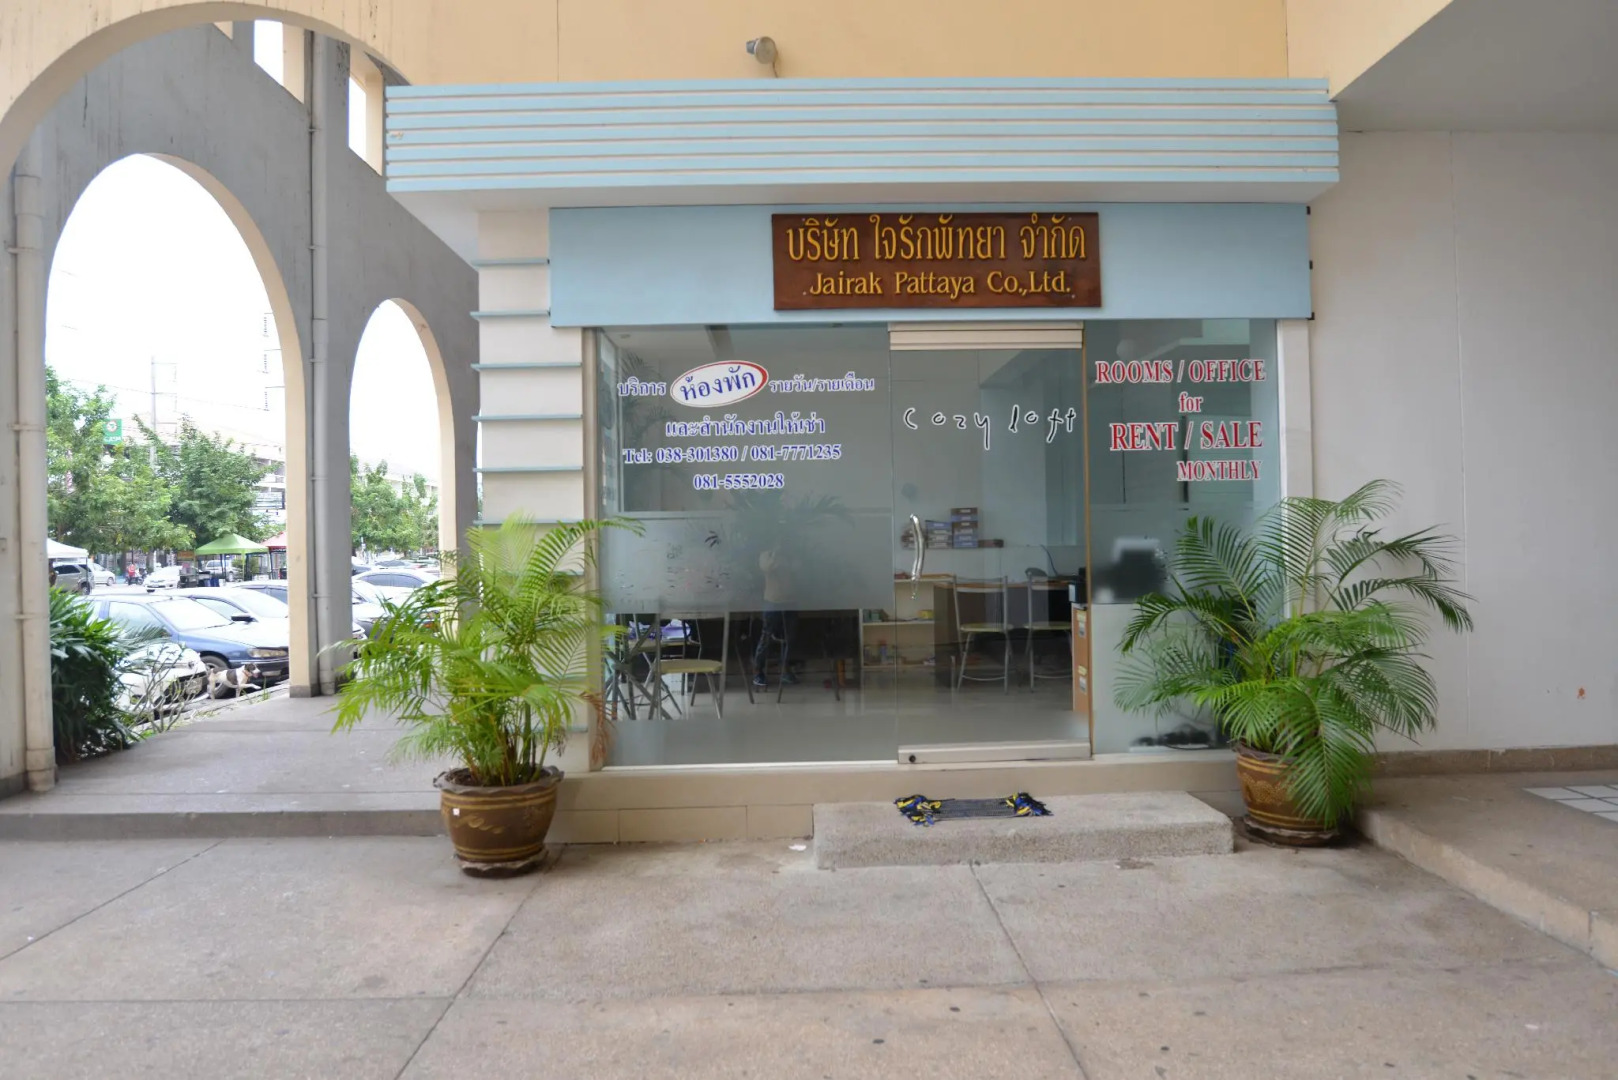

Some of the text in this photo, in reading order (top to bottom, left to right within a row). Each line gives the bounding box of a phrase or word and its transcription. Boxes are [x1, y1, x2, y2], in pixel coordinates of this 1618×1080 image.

[786, 212, 1087, 261] บริษัท ใจรักพัทยา จำกัด
[809, 270, 883, 295] Jairak
[894, 271, 975, 299] Pattaya
[617, 365, 875, 401] บริการ ห้องพัก รายวัน/รายเดือน
[1095, 360, 1174, 383] ROOMS
[1187, 359, 1266, 382] OFFICE
[1178, 391, 1203, 412] for
[665, 411, 825, 437] และสำนักงานให้เช่า
[1007, 404, 1077, 443] loft
[1109, 421, 1179, 451] RENT
[1200, 420, 1264, 449] SALE
[656, 446, 738, 463] 038-301380
[751, 443, 842, 461] 081-7771235
[693, 473, 785, 490] 081-5552028
[1176, 459, 1264, 482] MONTHLY
